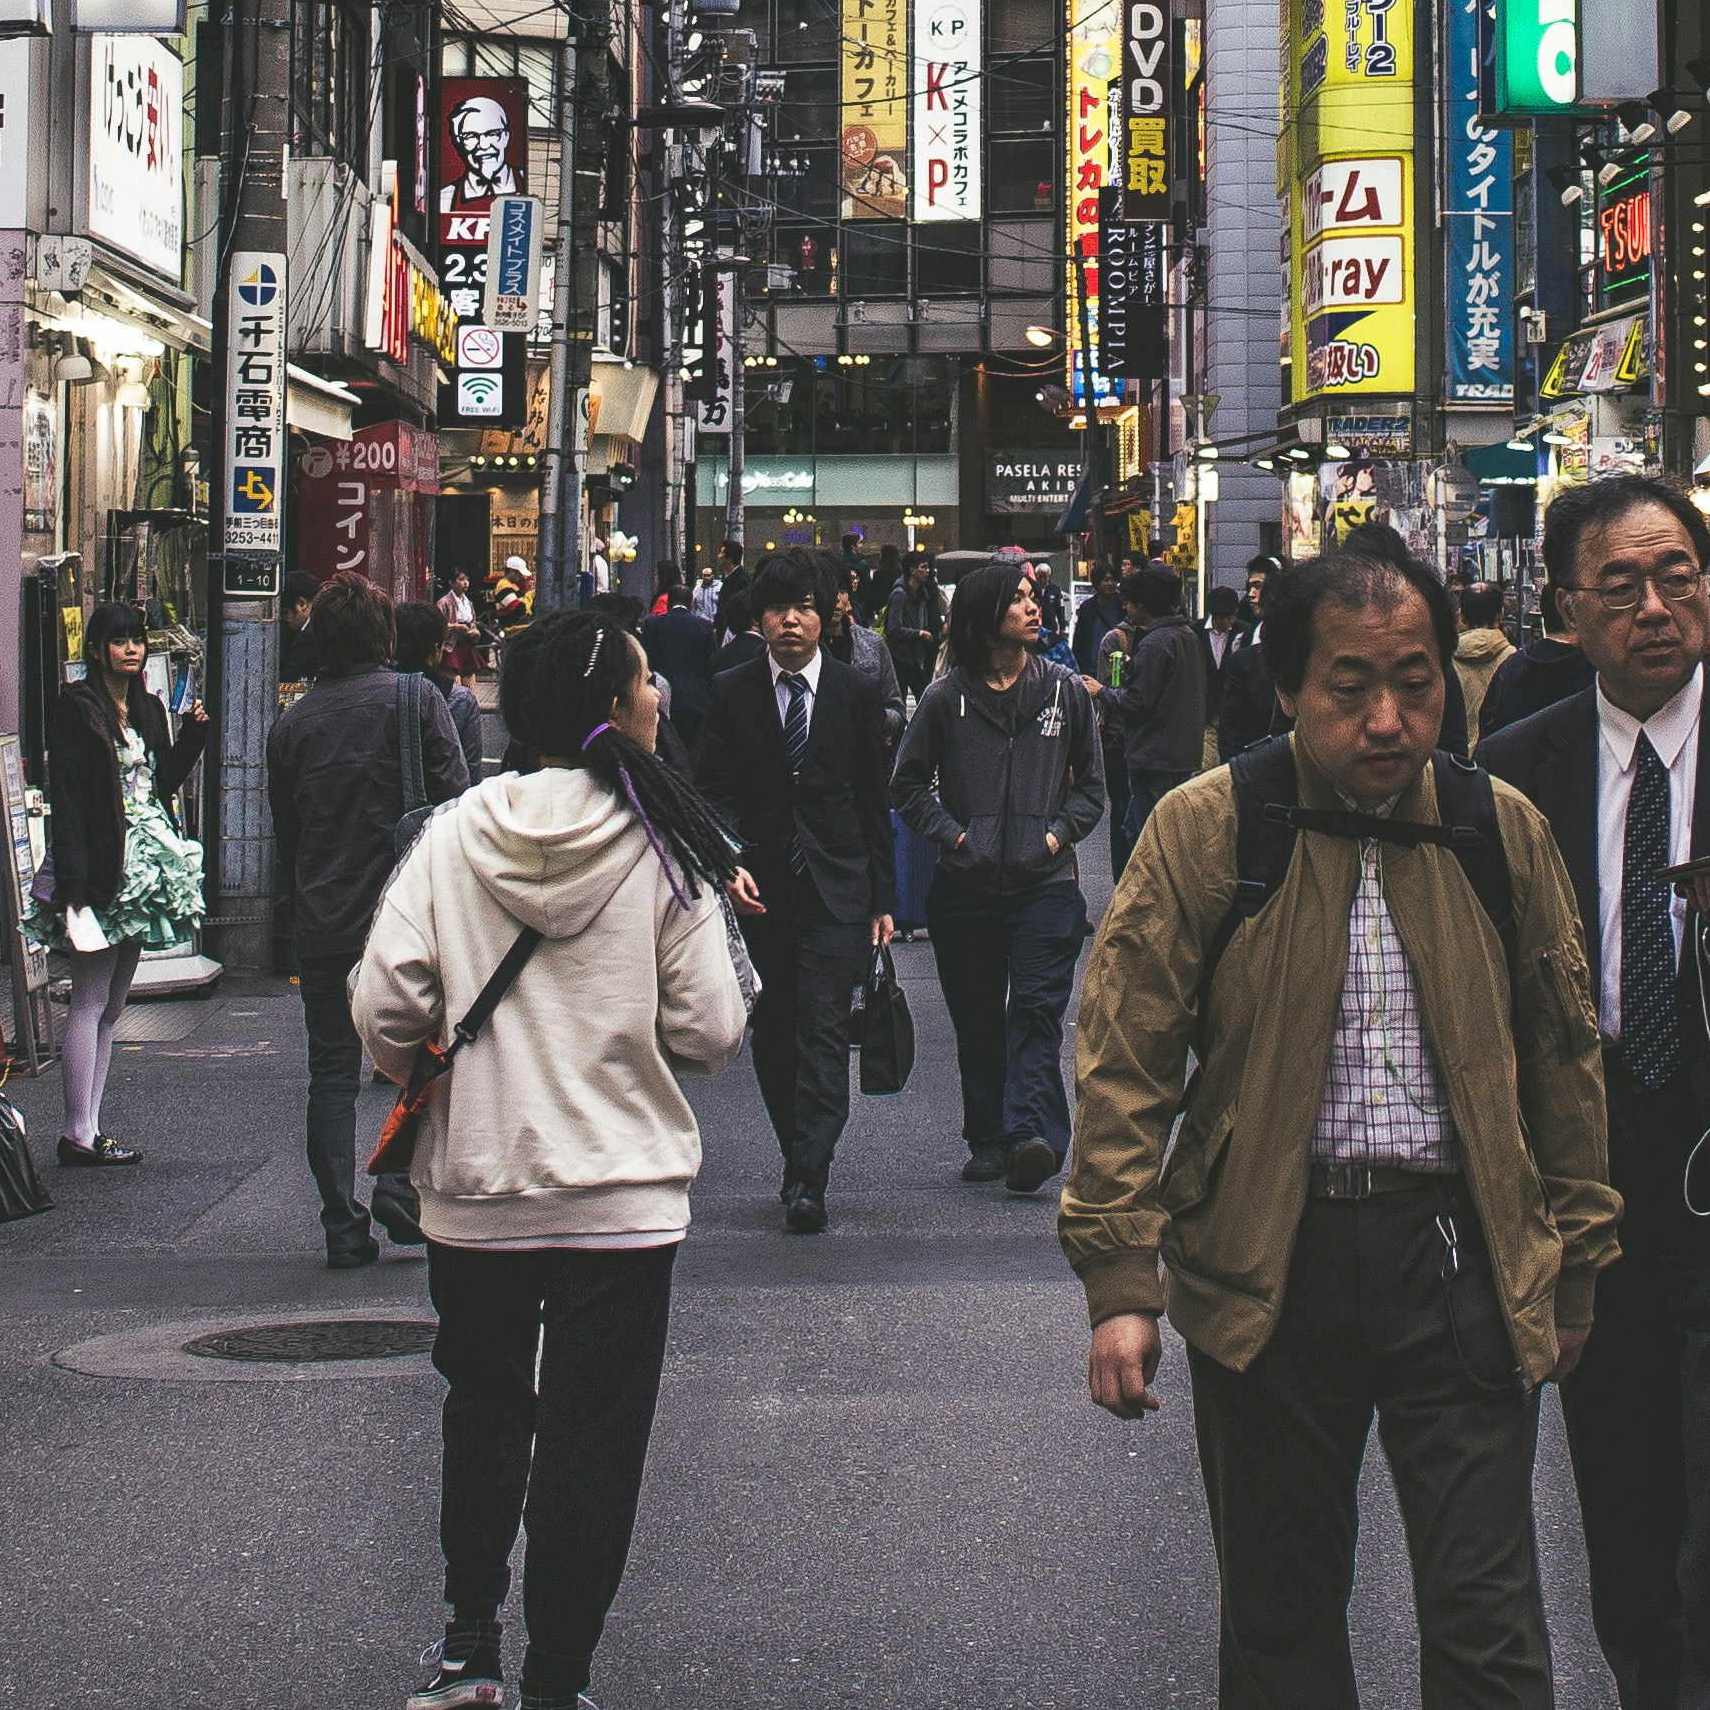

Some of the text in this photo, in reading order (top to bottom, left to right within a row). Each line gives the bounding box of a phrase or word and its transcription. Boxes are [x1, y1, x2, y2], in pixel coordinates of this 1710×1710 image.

[952, 60, 970, 207] アニメコラボカフェ
[503, 200, 527, 295] コスメイトプラス
[1107, 226, 1127, 371] ROOMPIA
[235, 315, 274, 459] 千石電商
[336, 440, 397, 471] ¥200
[995, 463, 1051, 477] PASELA
[325, 481, 367, 571] コイン
[236, 573, 271, 587] 1-10
